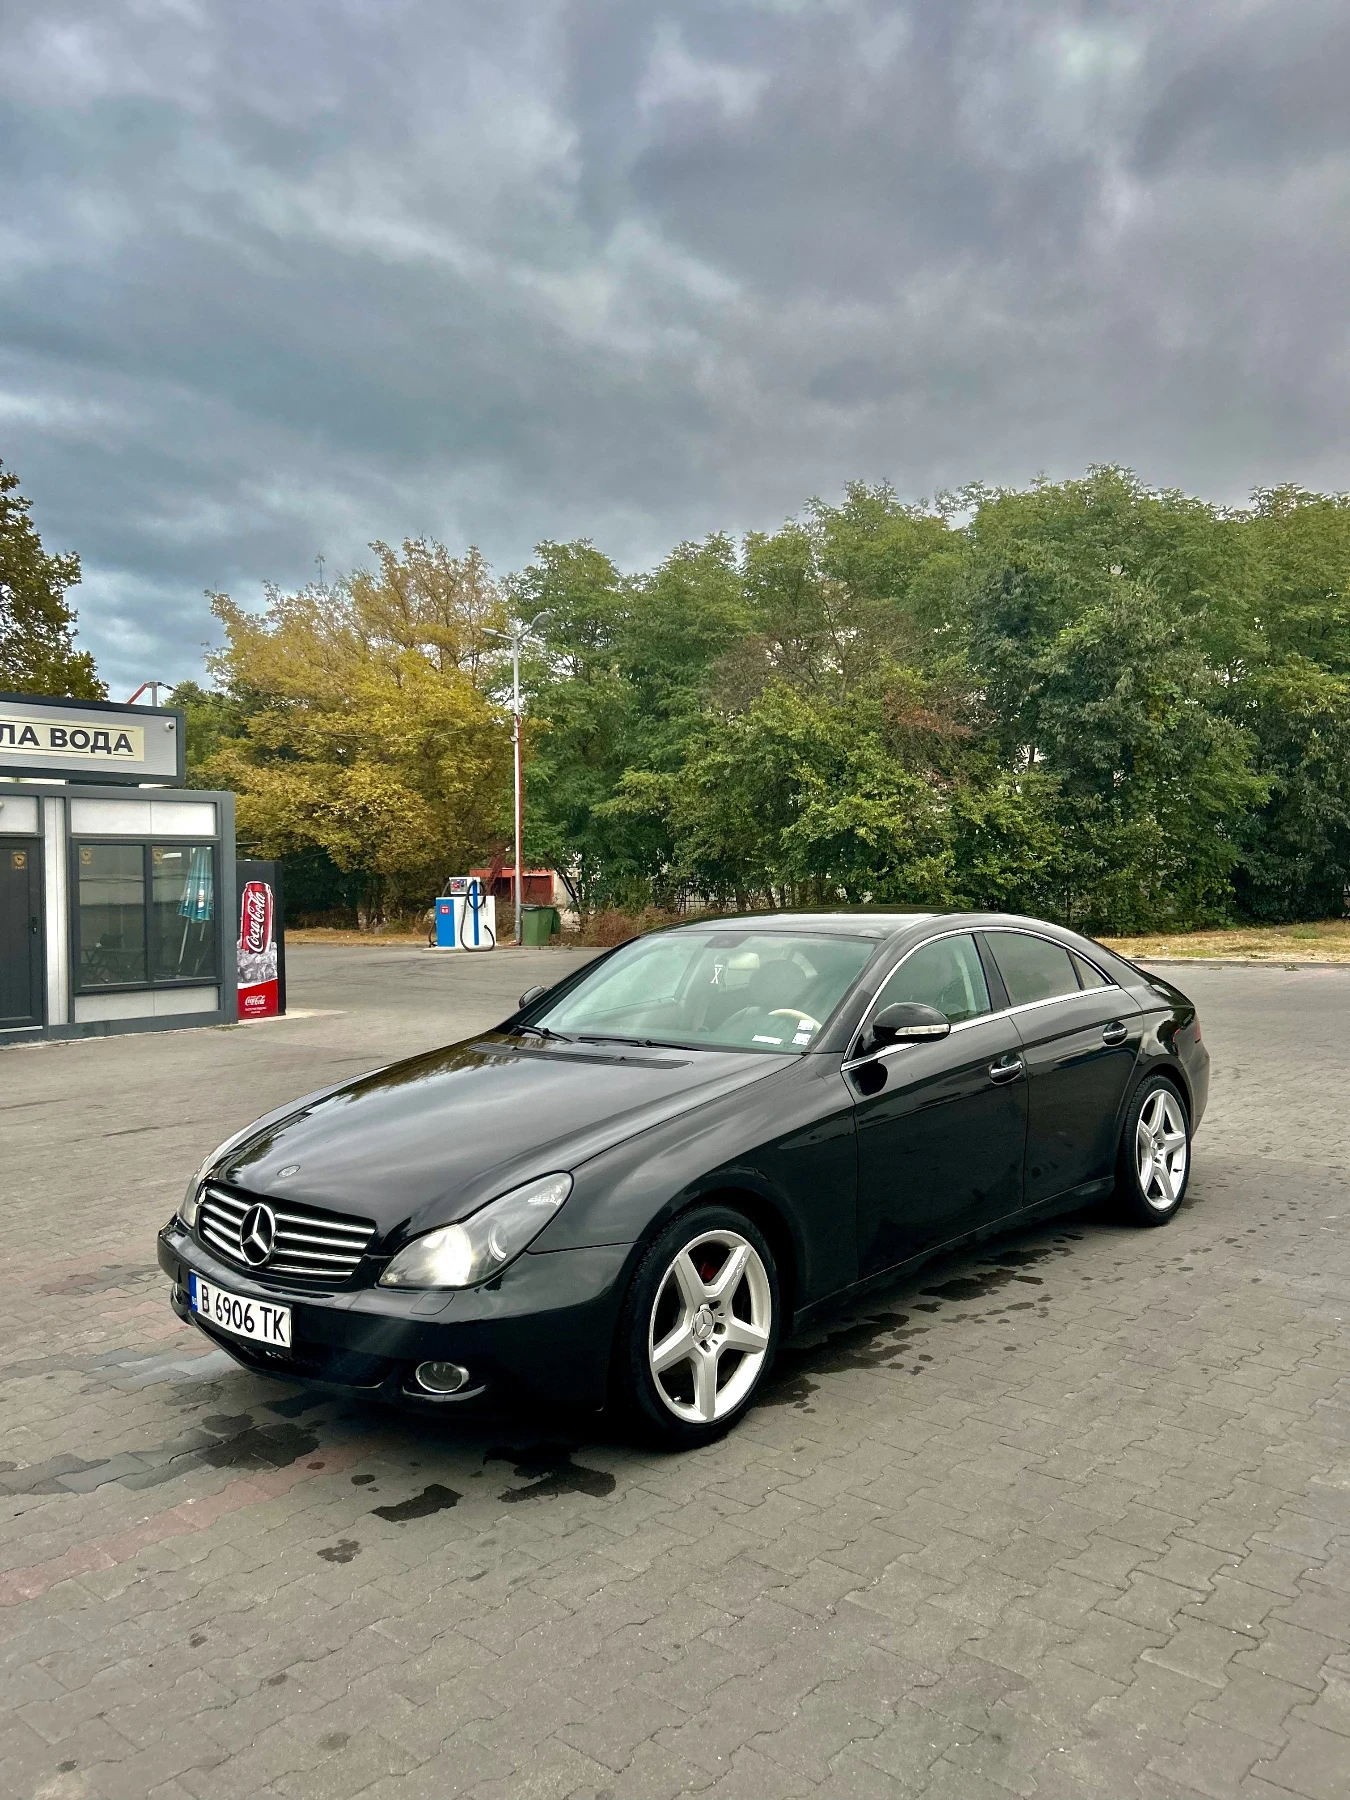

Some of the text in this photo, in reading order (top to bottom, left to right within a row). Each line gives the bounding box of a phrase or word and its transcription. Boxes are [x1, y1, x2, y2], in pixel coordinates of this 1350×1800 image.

[50, 728, 134, 754] ВОДА
[245, 889, 266, 952] Coca-Cola
[201, 1284, 286, 1342] B 6906 TK
